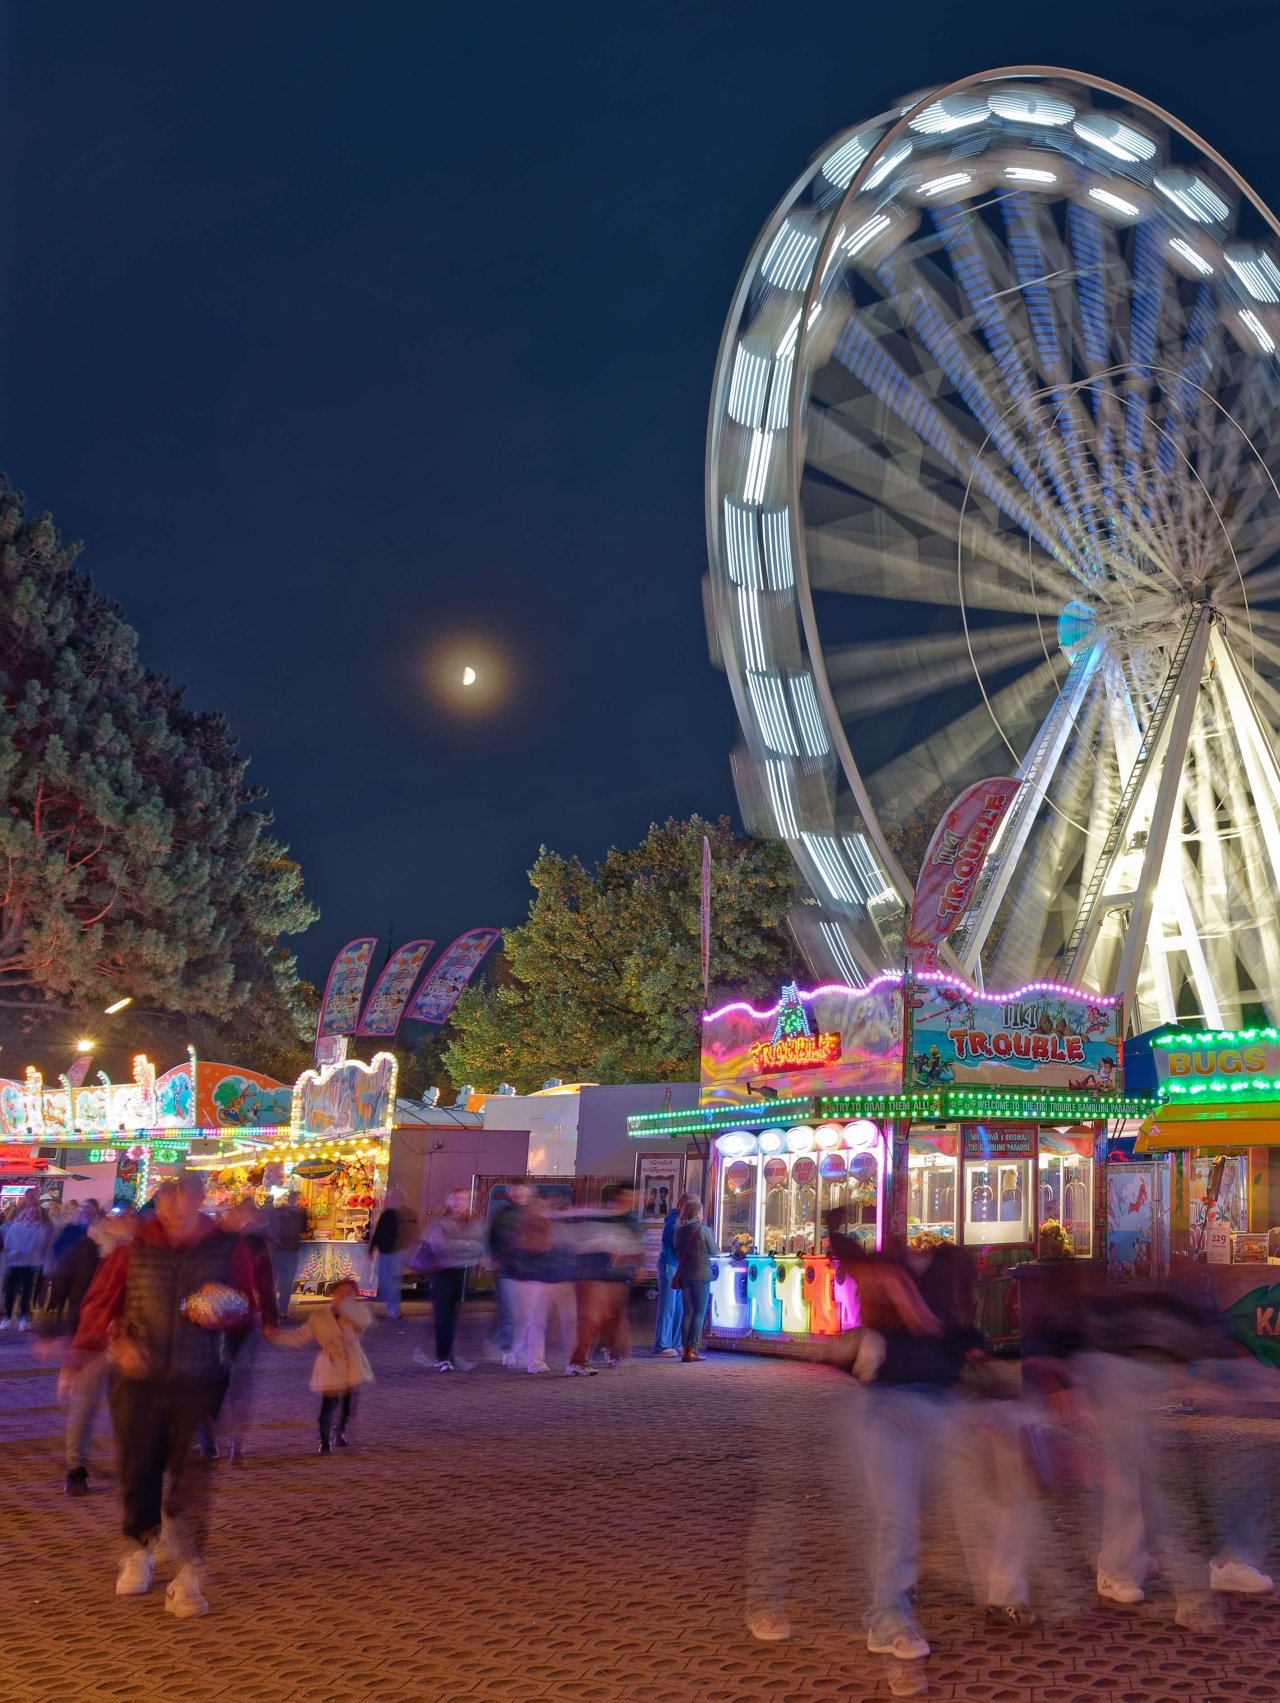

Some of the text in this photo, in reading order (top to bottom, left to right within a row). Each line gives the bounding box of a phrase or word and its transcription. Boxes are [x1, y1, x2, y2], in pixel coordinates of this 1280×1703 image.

[932, 829, 963, 865] TIKI
[937, 794, 1006, 917] TROUBLE
[1001, 1002, 1038, 1029] TIKI
[949, 1029, 1085, 1063] TROUBLE
[1168, 1049, 1266, 1077] BUGS
[835, 1101, 930, 1112] TRY TO GRAB THEM ALL!
[977, 1100, 1139, 1114] WELCOME TO THE TIKI TROUBLE GAMBLING PARADISE
[1004, 1133, 1028, 1141] ORIGINAL
[1007, 1143, 1032, 1151] PARADISE
[1212, 1234, 1227, 1245] 229
